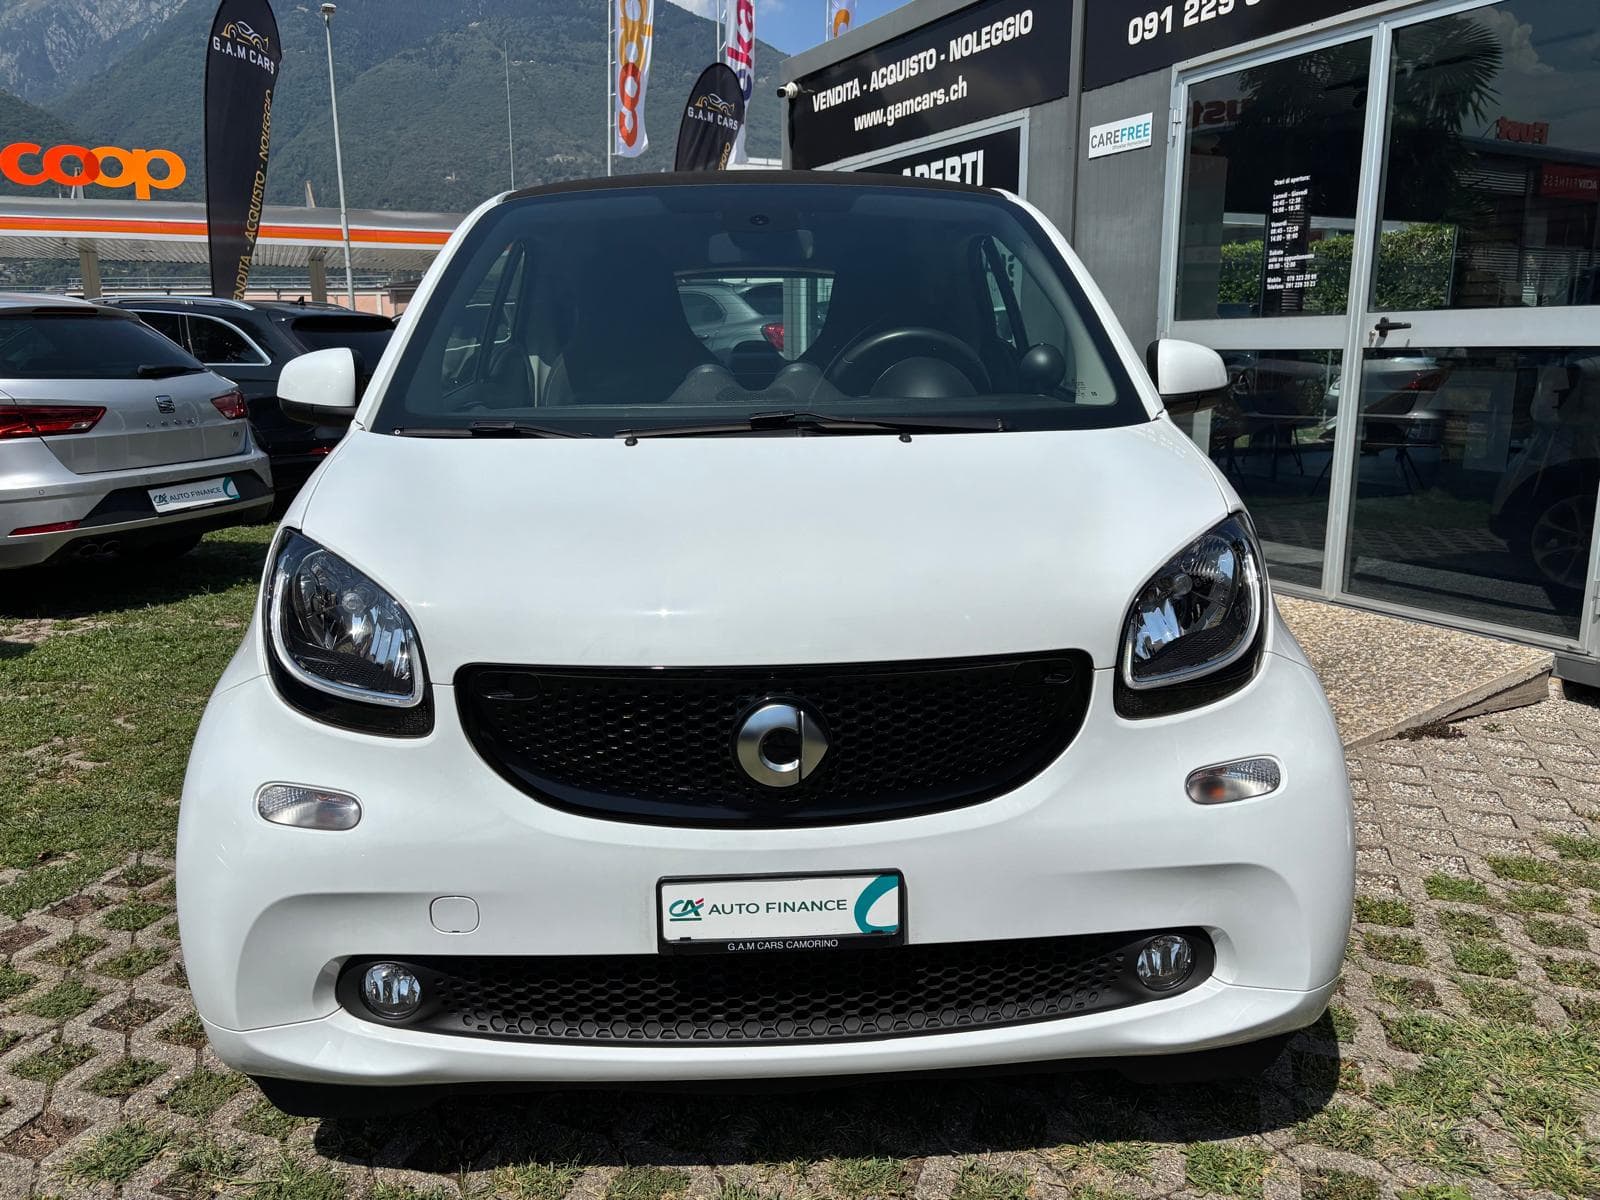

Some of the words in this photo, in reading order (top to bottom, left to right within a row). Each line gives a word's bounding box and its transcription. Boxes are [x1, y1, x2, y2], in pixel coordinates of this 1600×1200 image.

[1128, 5, 1173, 45] 091
[213, 36, 246, 60] G.A.M
[249, 50, 275, 75] CARS
[812, 78, 860, 113] VENDITA
[870, 48, 936, 92] ACQUISTO
[949, 9, 1034, 63] NOLEGGIO
[687, 106, 713, 123] G.A.M
[717, 114, 738, 130] CARS
[853, 75, 968, 132] www.gamcars.ch
[1090, 122, 1151, 149] CAREFREE
[0, 142, 187, 200] coop
[233, 255, 251, 301] ENDITA
[245, 170, 265, 242] ACQUISTO
[170, 492, 190, 502] AUTO
[191, 486, 222, 498] FINANCE
[708, 902, 760, 916] AUTO
[765, 899, 848, 914] FINANCE
[728, 943, 755, 951] G.A.M
[757, 941, 784, 950] CARS
[786, 939, 839, 949] CAMORINO
